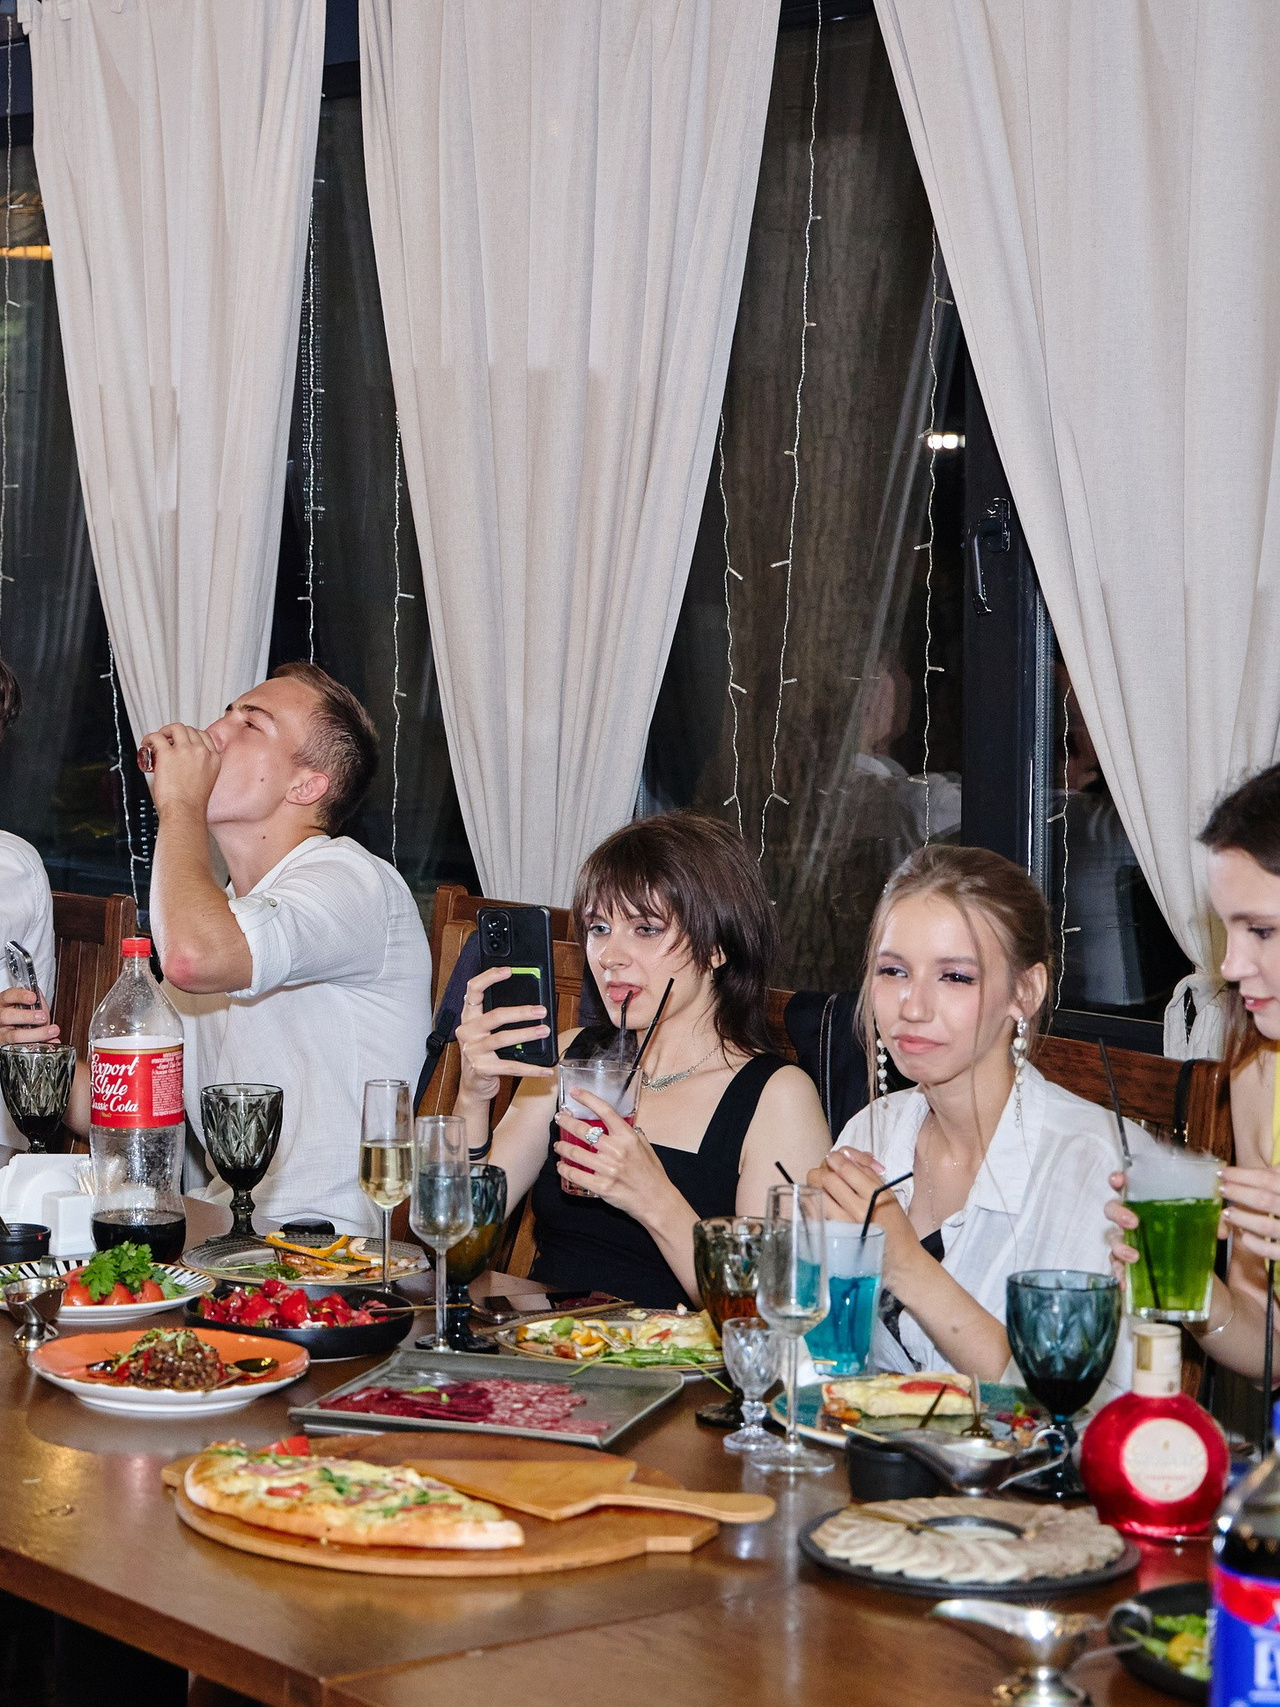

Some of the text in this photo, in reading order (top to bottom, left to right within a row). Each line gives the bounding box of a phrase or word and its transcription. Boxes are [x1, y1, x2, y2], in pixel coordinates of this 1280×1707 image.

[91, 1053, 139, 1084] Export
[94, 1075, 128, 1101] Style
[110, 1096, 139, 1112] Cola
